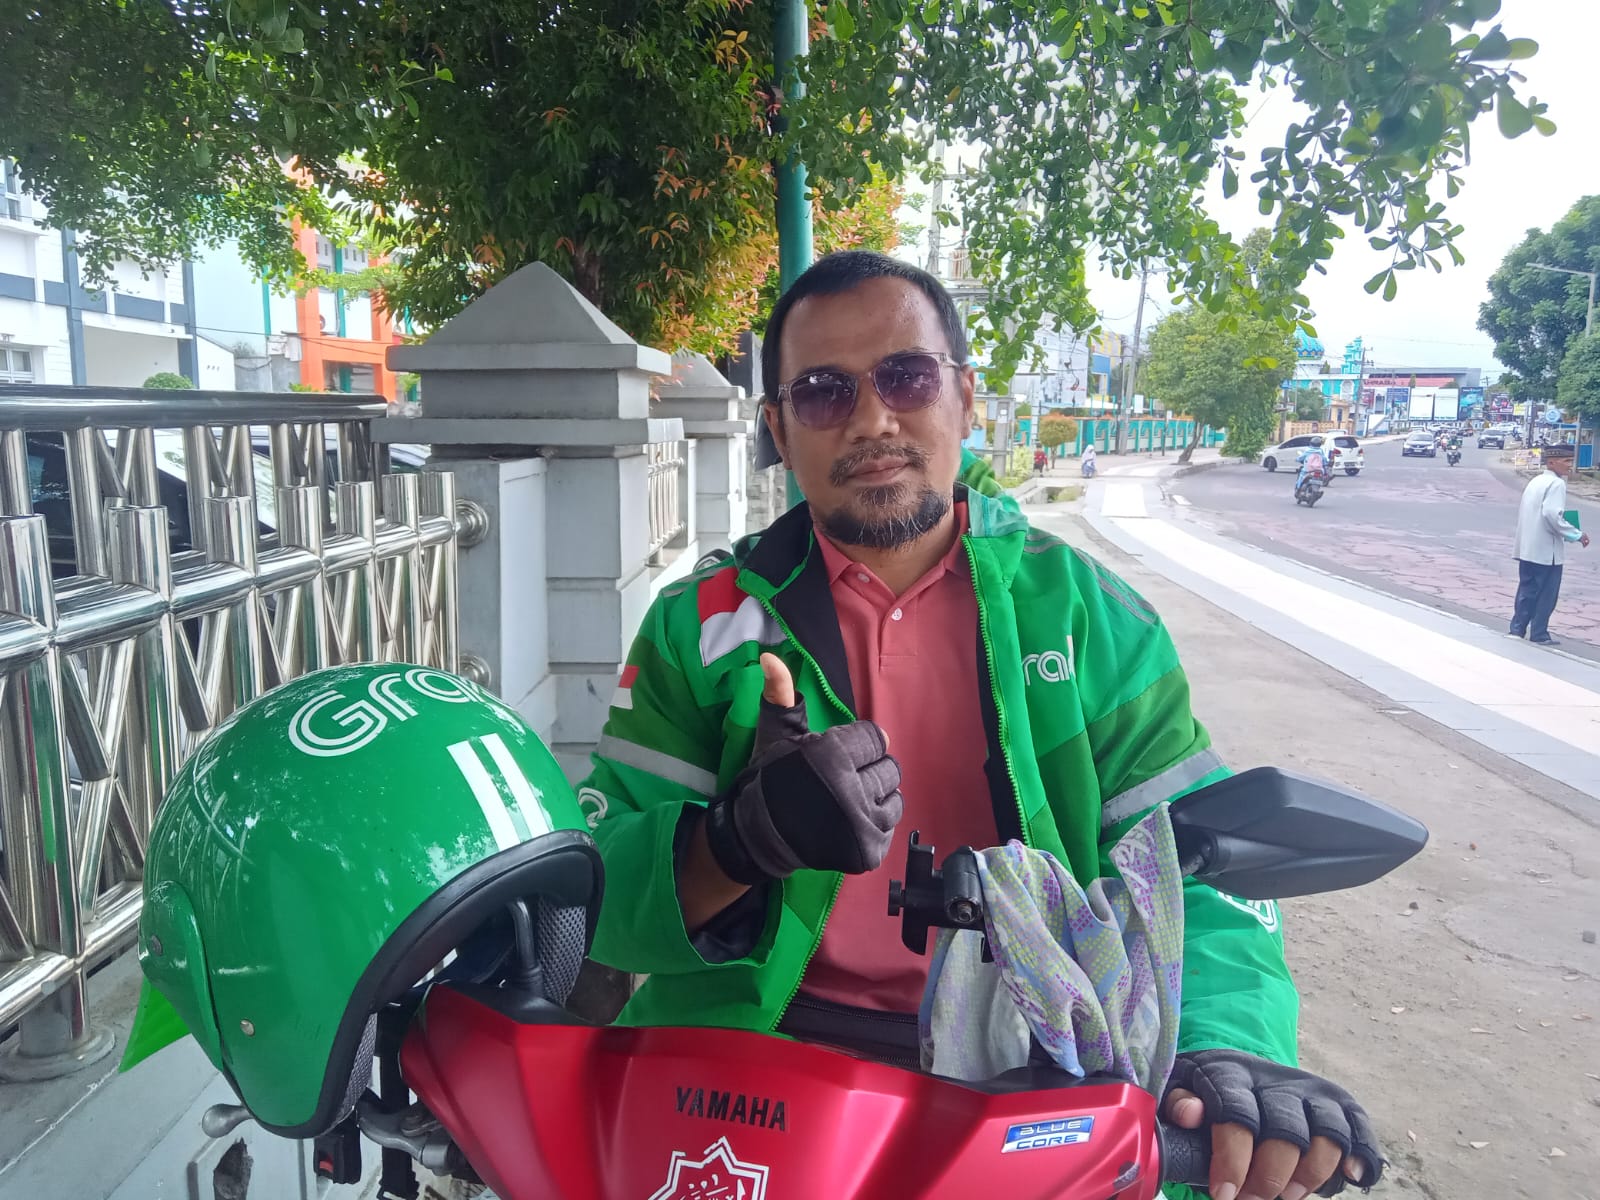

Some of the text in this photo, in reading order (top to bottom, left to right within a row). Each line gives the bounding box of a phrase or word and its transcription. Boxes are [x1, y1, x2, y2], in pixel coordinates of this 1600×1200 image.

[288, 667, 486, 757] Gra
[675, 1086, 786, 1132] YAMAHA
[1016, 1134, 1079, 1150] CORE
[1020, 1119, 1082, 1136] BLUE
